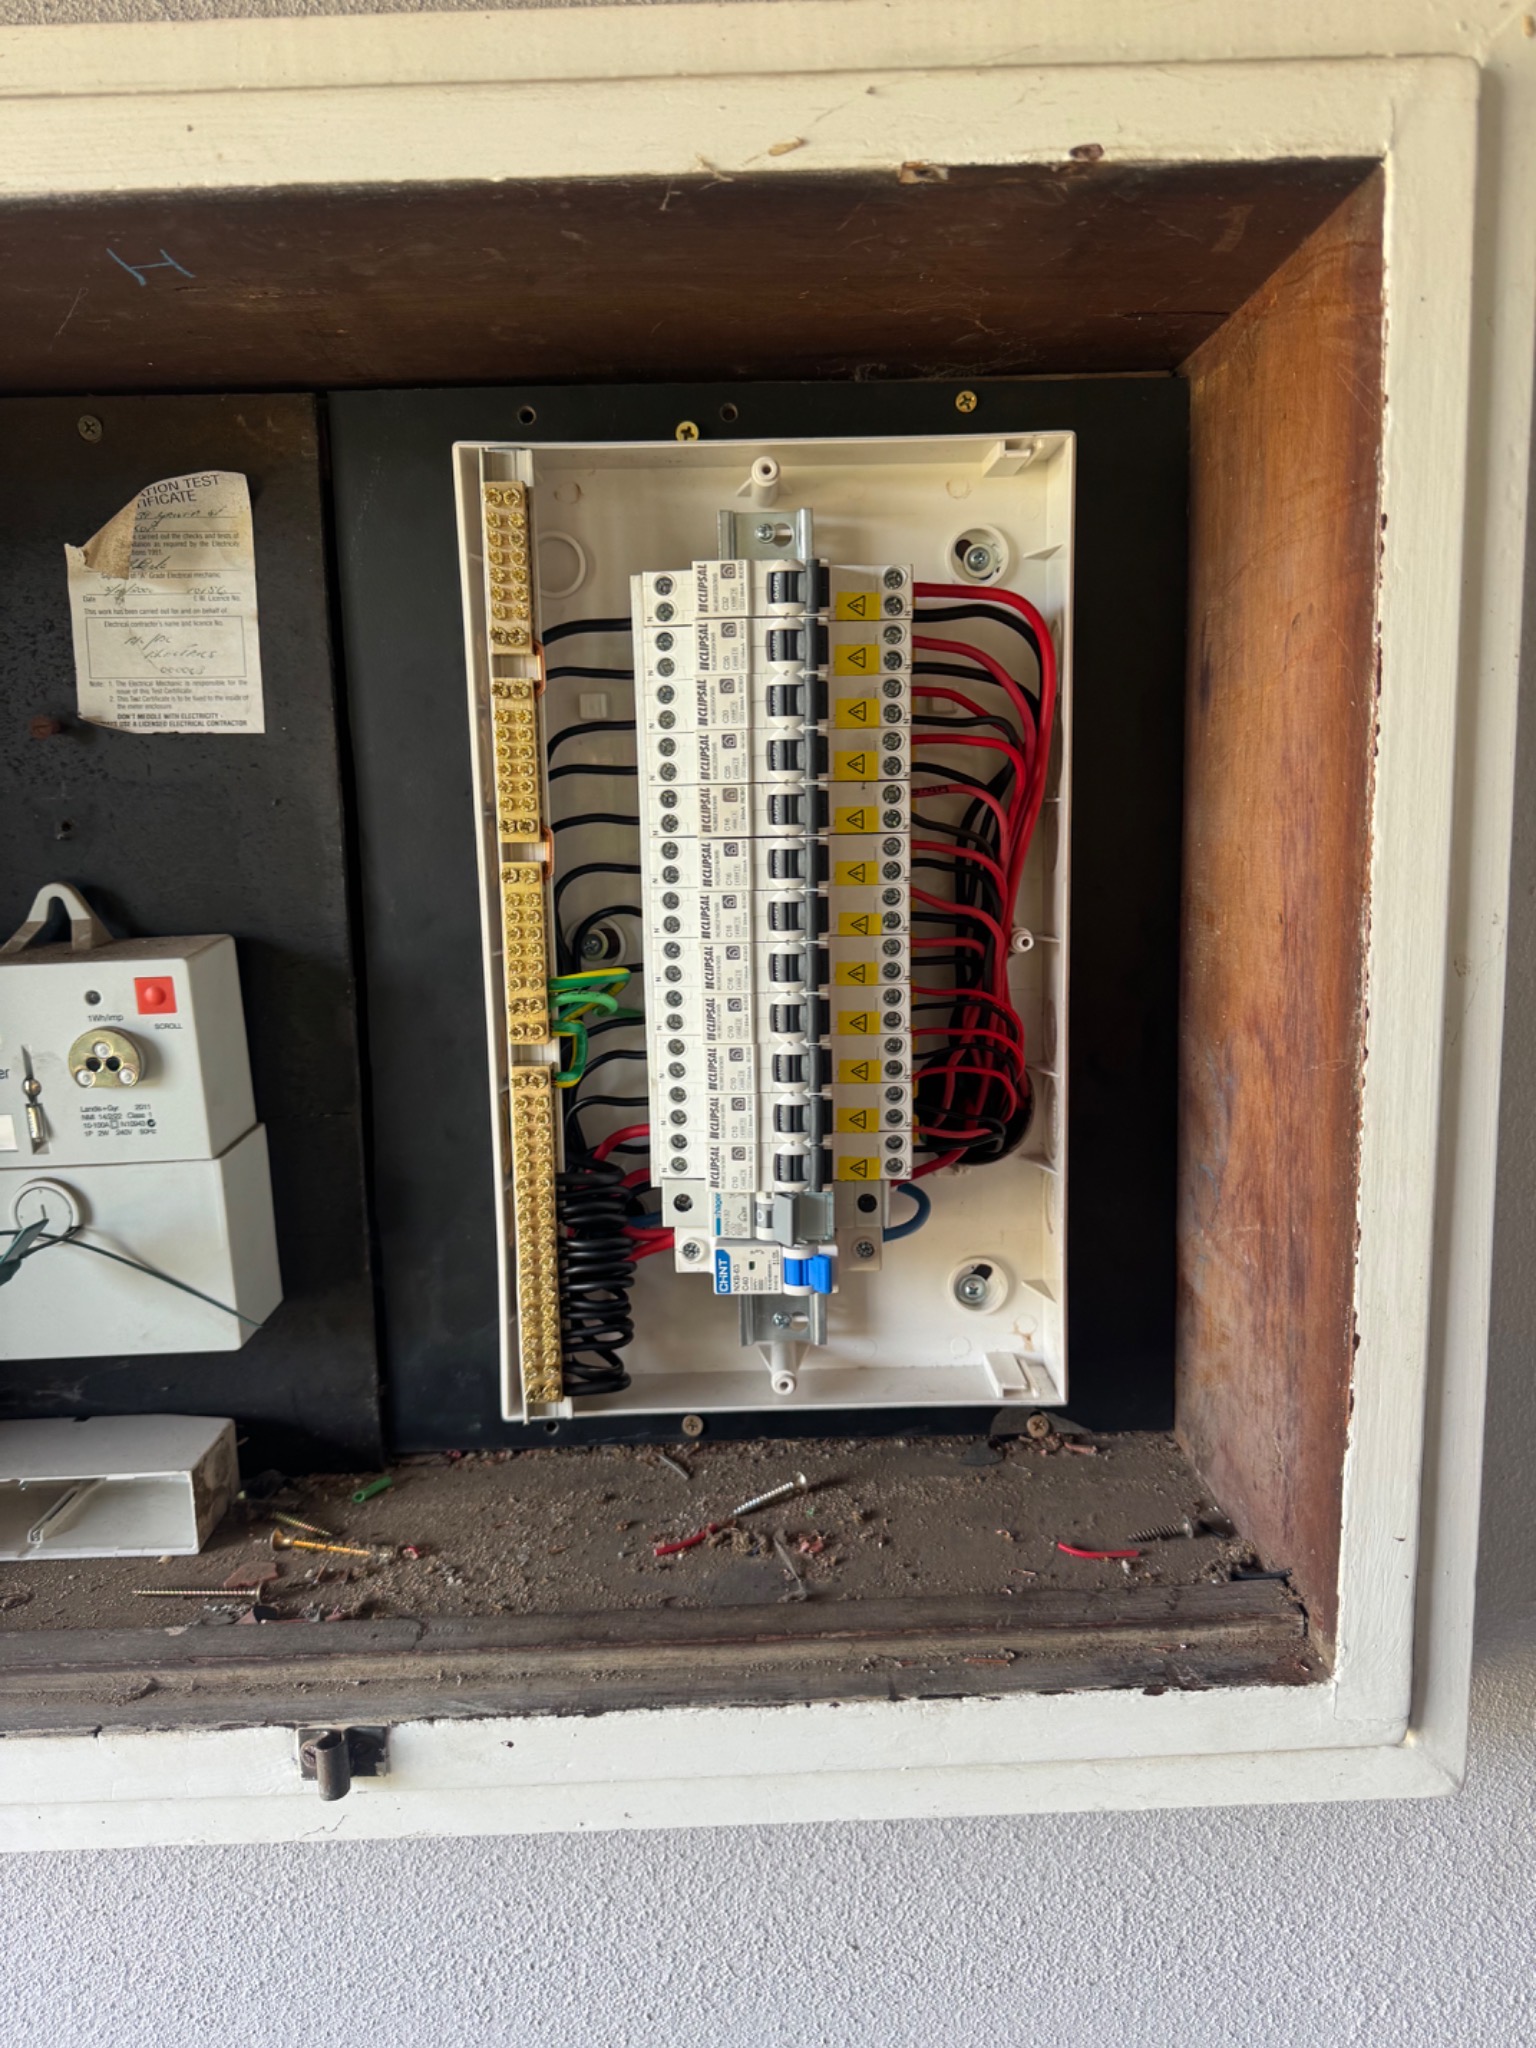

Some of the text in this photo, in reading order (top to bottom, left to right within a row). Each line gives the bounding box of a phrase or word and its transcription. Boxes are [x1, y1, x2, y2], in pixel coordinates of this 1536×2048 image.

[183, 474, 219, 489] TEST
[696, 564, 708, 602] CLIPSAL
[697, 623, 709, 661] CLIPSAL
[696, 679, 708, 717] CLIPSAL
[698, 734, 710, 771] CLIPSAL
[700, 788, 711, 824] CLIPSAL
[700, 843, 712, 878] CLIPSAL
[700, 895, 711, 930] CLIPSAL
[703, 946, 714, 980] CLIPSAL
[705, 998, 715, 1032] CLIPSAL
[707, 1048, 717, 1083] CLIPSAL
[709, 1097, 719, 1132] CLIPSAL
[709, 1146, 720, 1181] CLIPSAL
